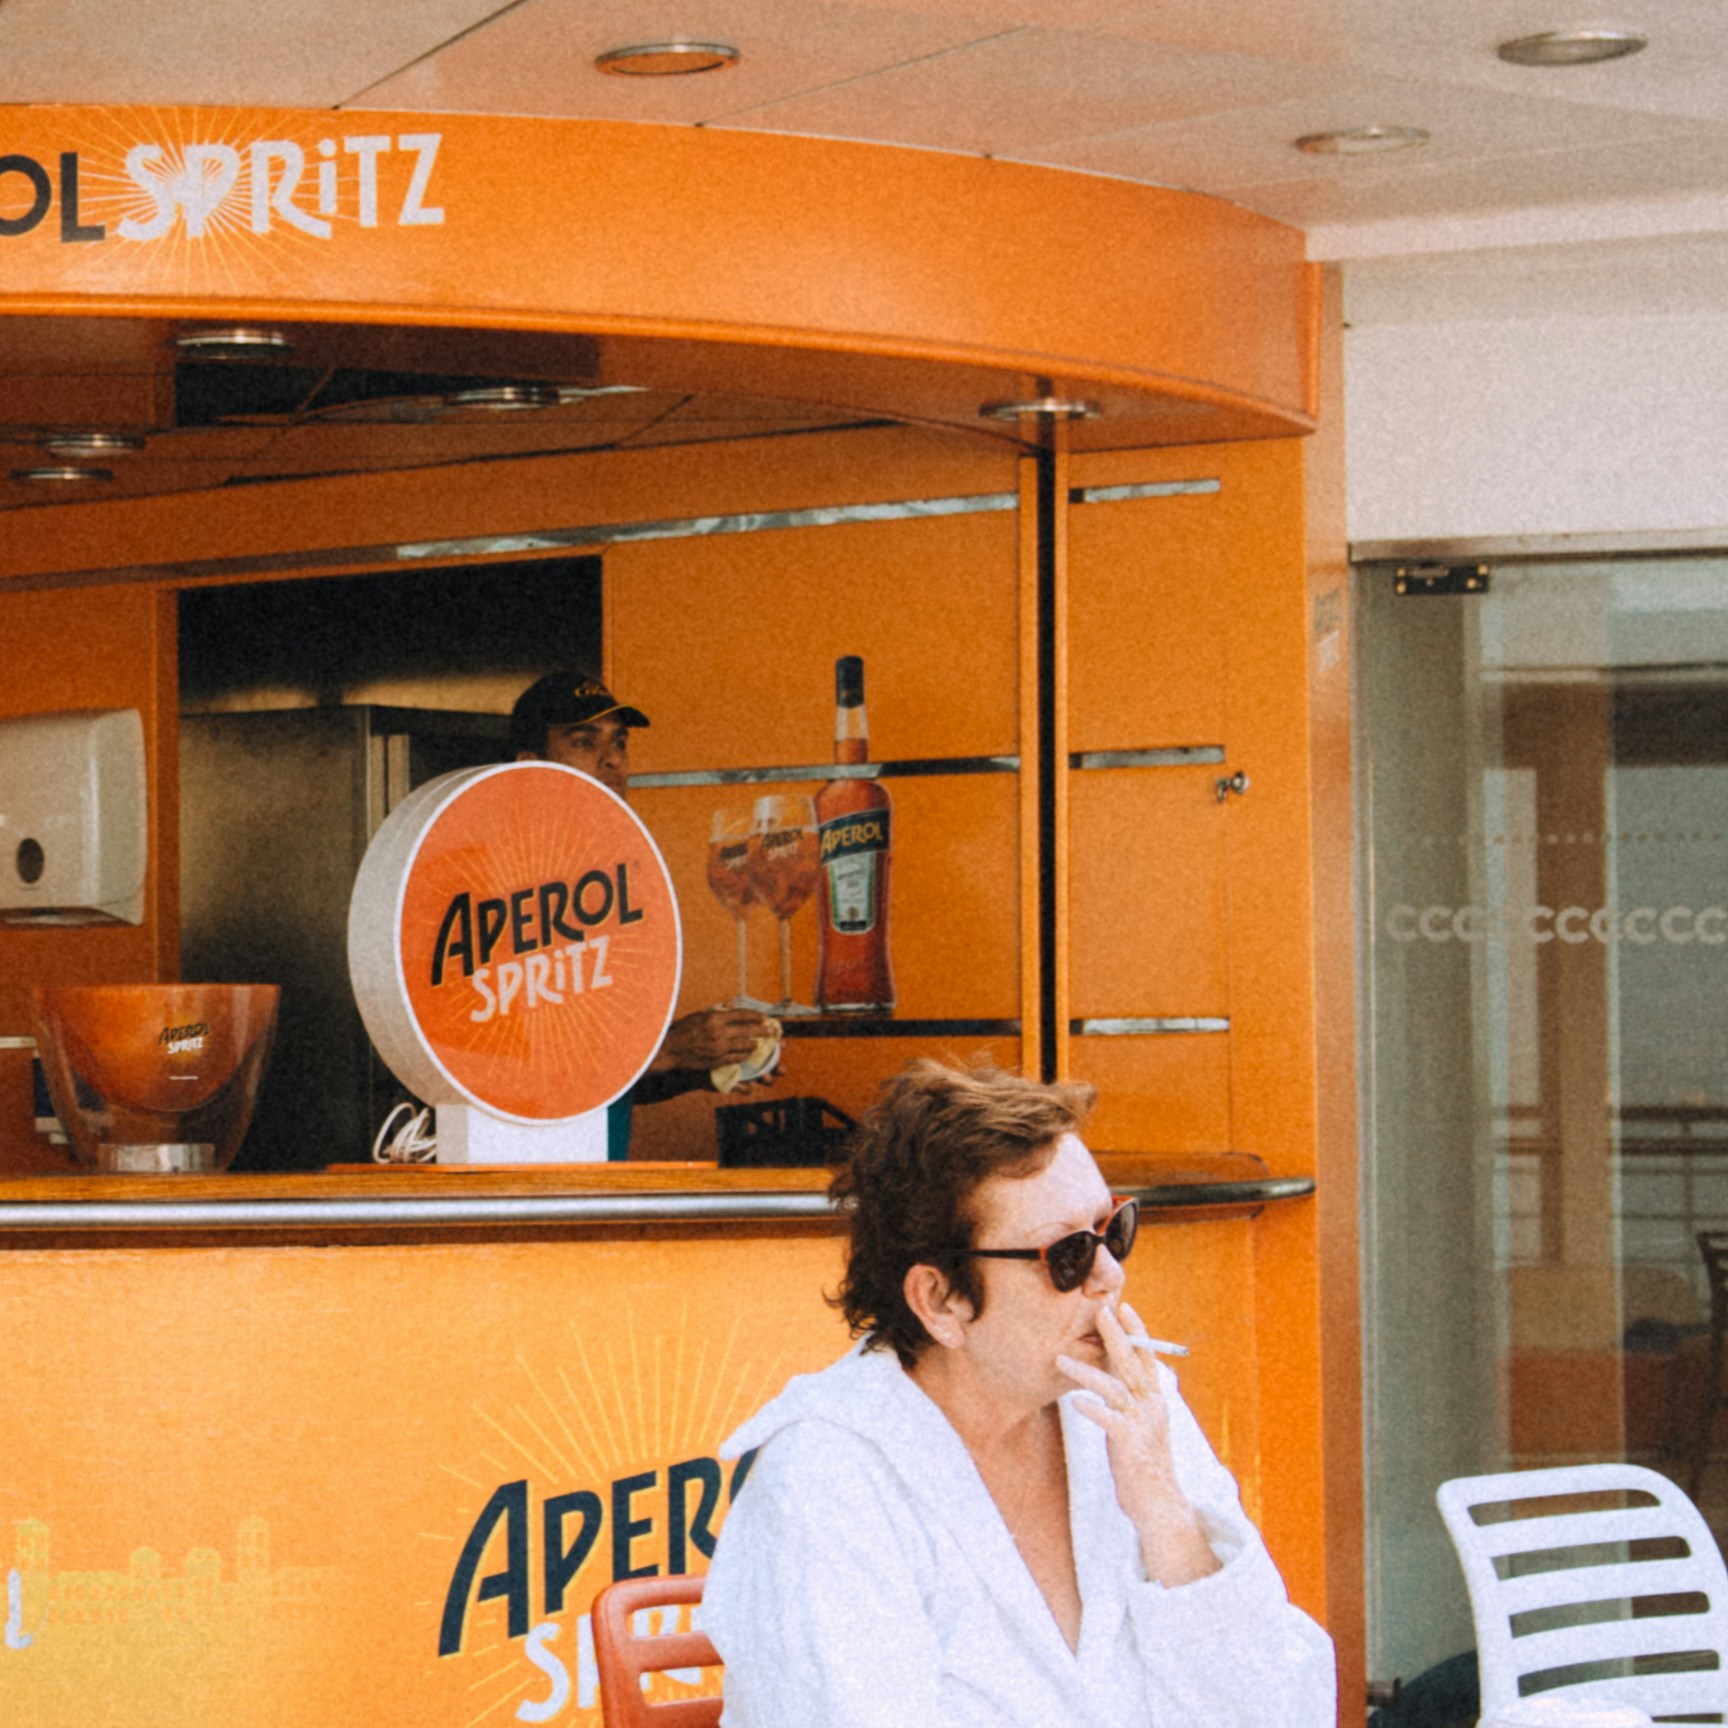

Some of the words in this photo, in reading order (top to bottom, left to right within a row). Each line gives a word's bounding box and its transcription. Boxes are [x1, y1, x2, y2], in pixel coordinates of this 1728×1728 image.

[822, 821, 884, 862] APEROL
[431, 862, 644, 988] APEROL
[438, 1446, 760, 1658] APER
